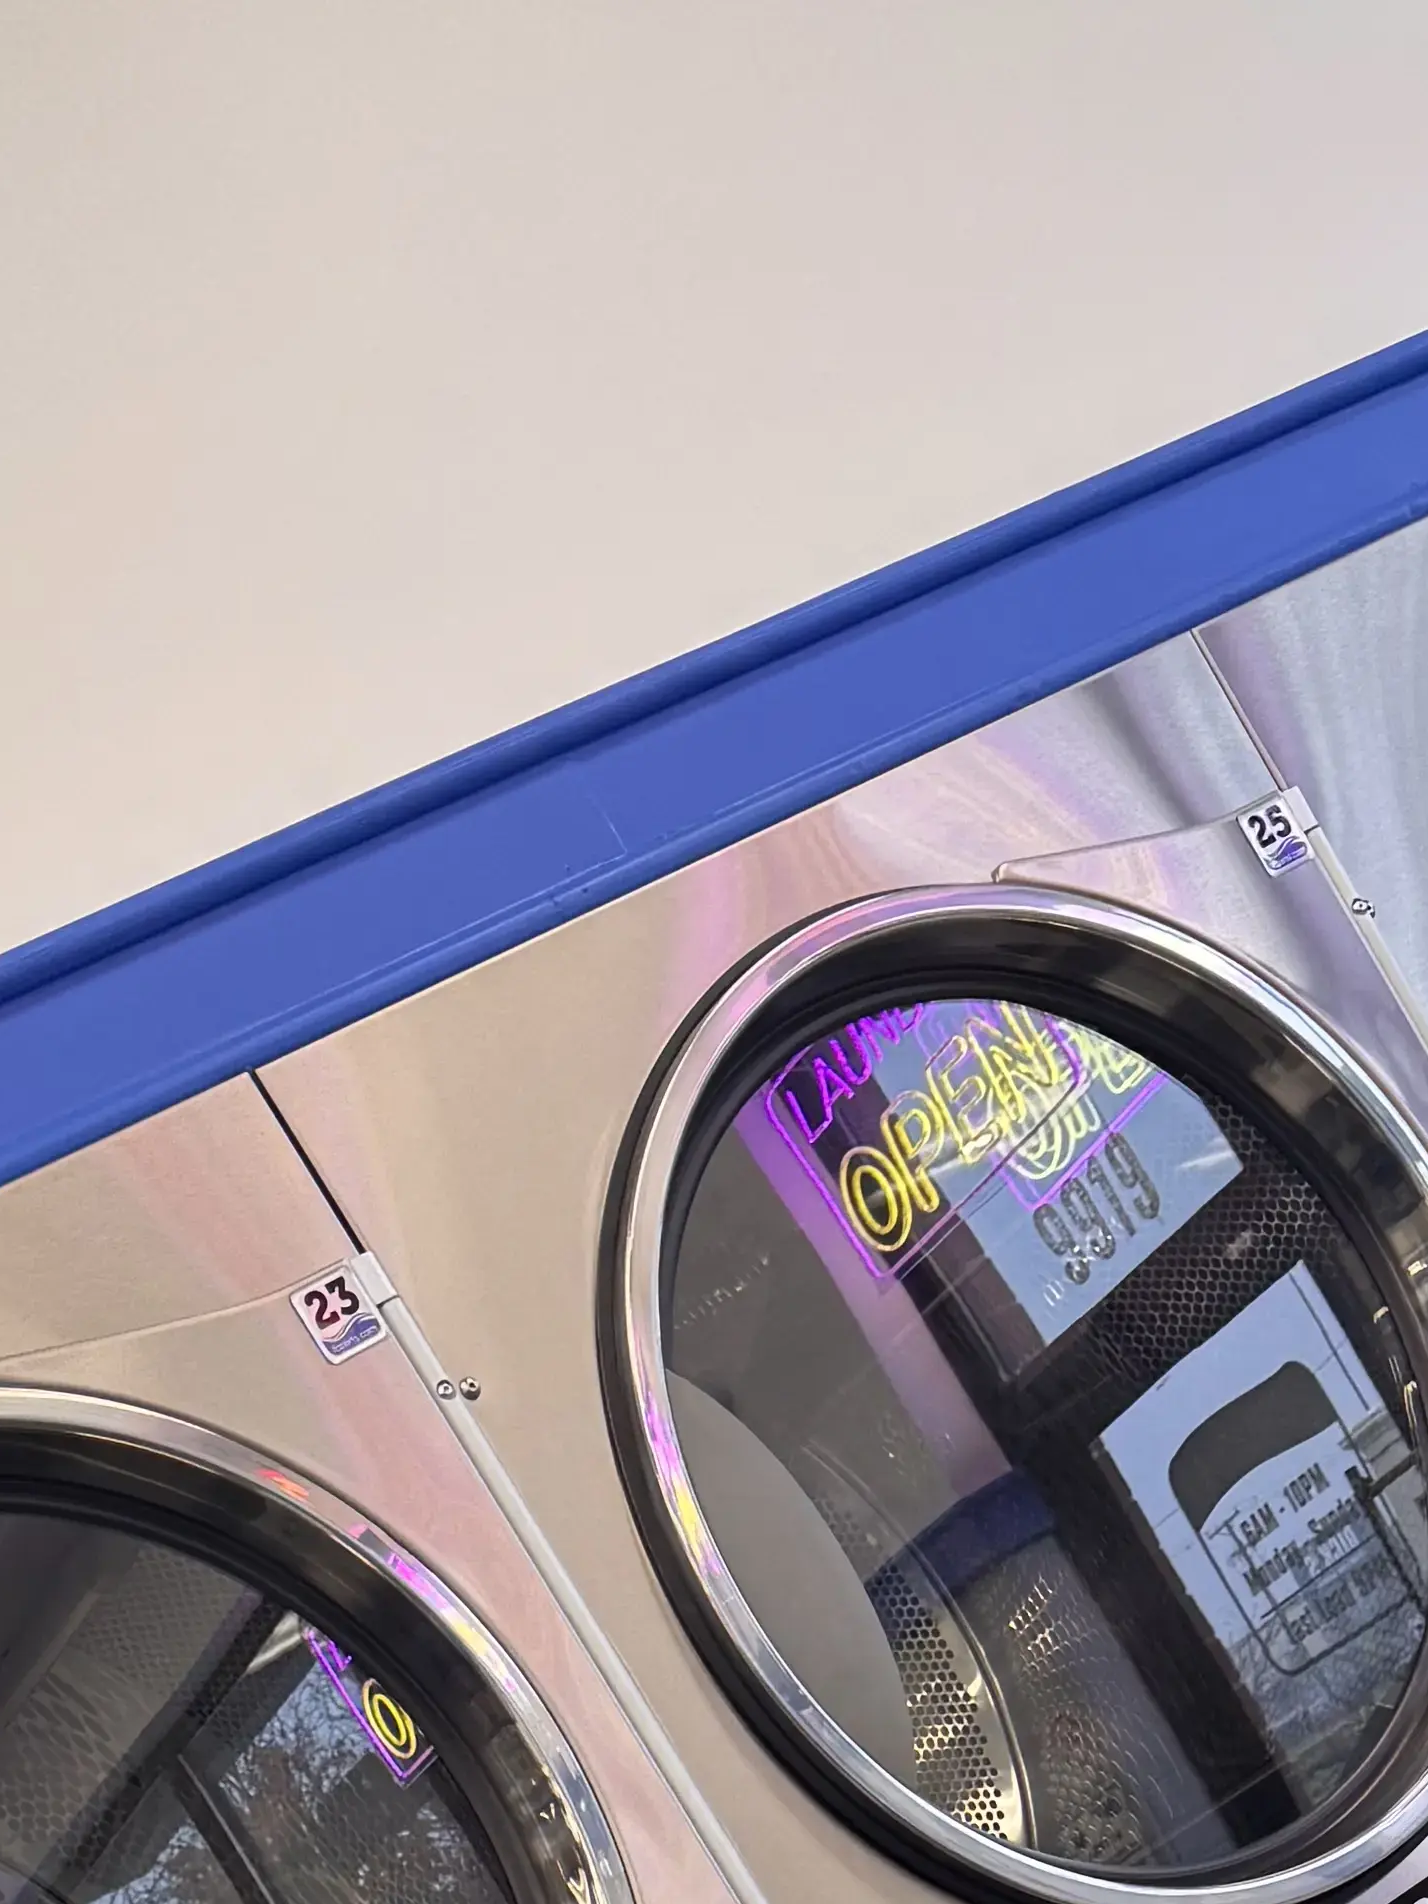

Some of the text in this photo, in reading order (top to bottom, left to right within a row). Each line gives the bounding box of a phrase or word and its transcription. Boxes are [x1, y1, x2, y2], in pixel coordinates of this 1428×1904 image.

[1248, 804, 1292, 848] 25
[304, 1276, 360, 1325] 23
[1283, 1462, 1331, 1513] 10PM
[1307, 1498, 1364, 1546] Sunda
